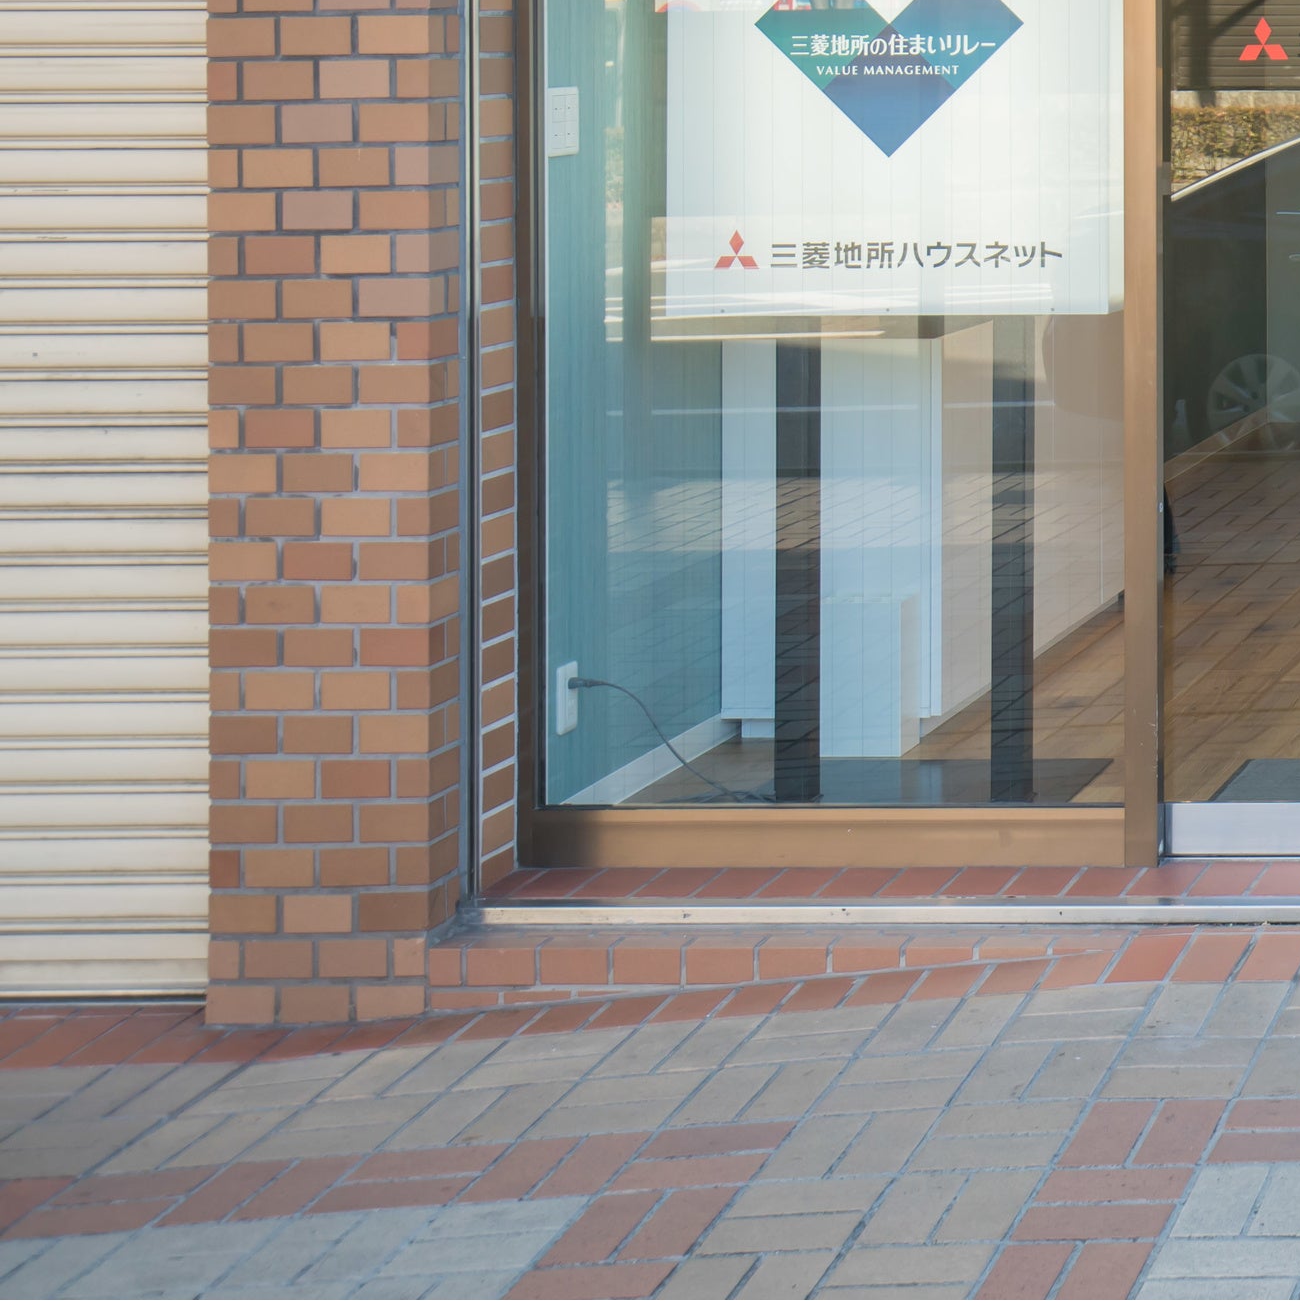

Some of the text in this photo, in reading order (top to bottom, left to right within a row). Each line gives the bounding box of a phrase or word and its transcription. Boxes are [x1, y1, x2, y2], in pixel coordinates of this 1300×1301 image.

[790, 34, 997, 56] 三菱地所の住まいリレー
[816, 65, 960, 75] VALUE MANAGEMENT
[770, 240, 1063, 269] 三菱地所ハウスネット
